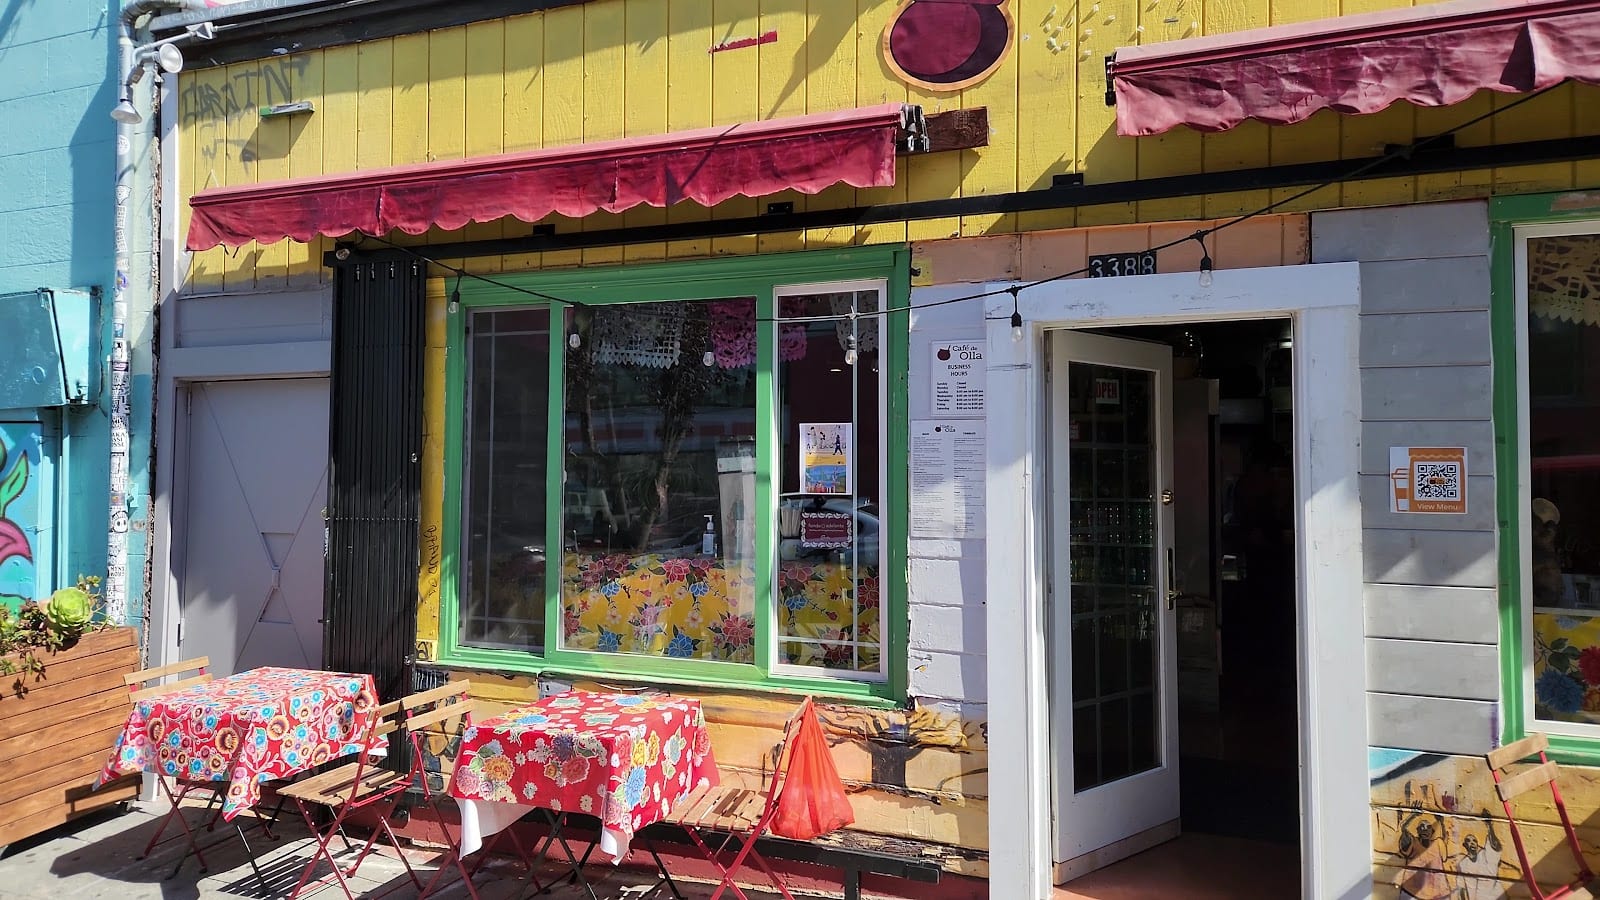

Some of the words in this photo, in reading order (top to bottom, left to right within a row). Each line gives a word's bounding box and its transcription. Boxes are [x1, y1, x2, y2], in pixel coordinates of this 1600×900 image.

[1091, 256, 1154, 277] 3388
[952, 344, 970, 352] Café
[960, 351, 983, 360] Olla
[1095, 382, 1117, 399] OPEN
